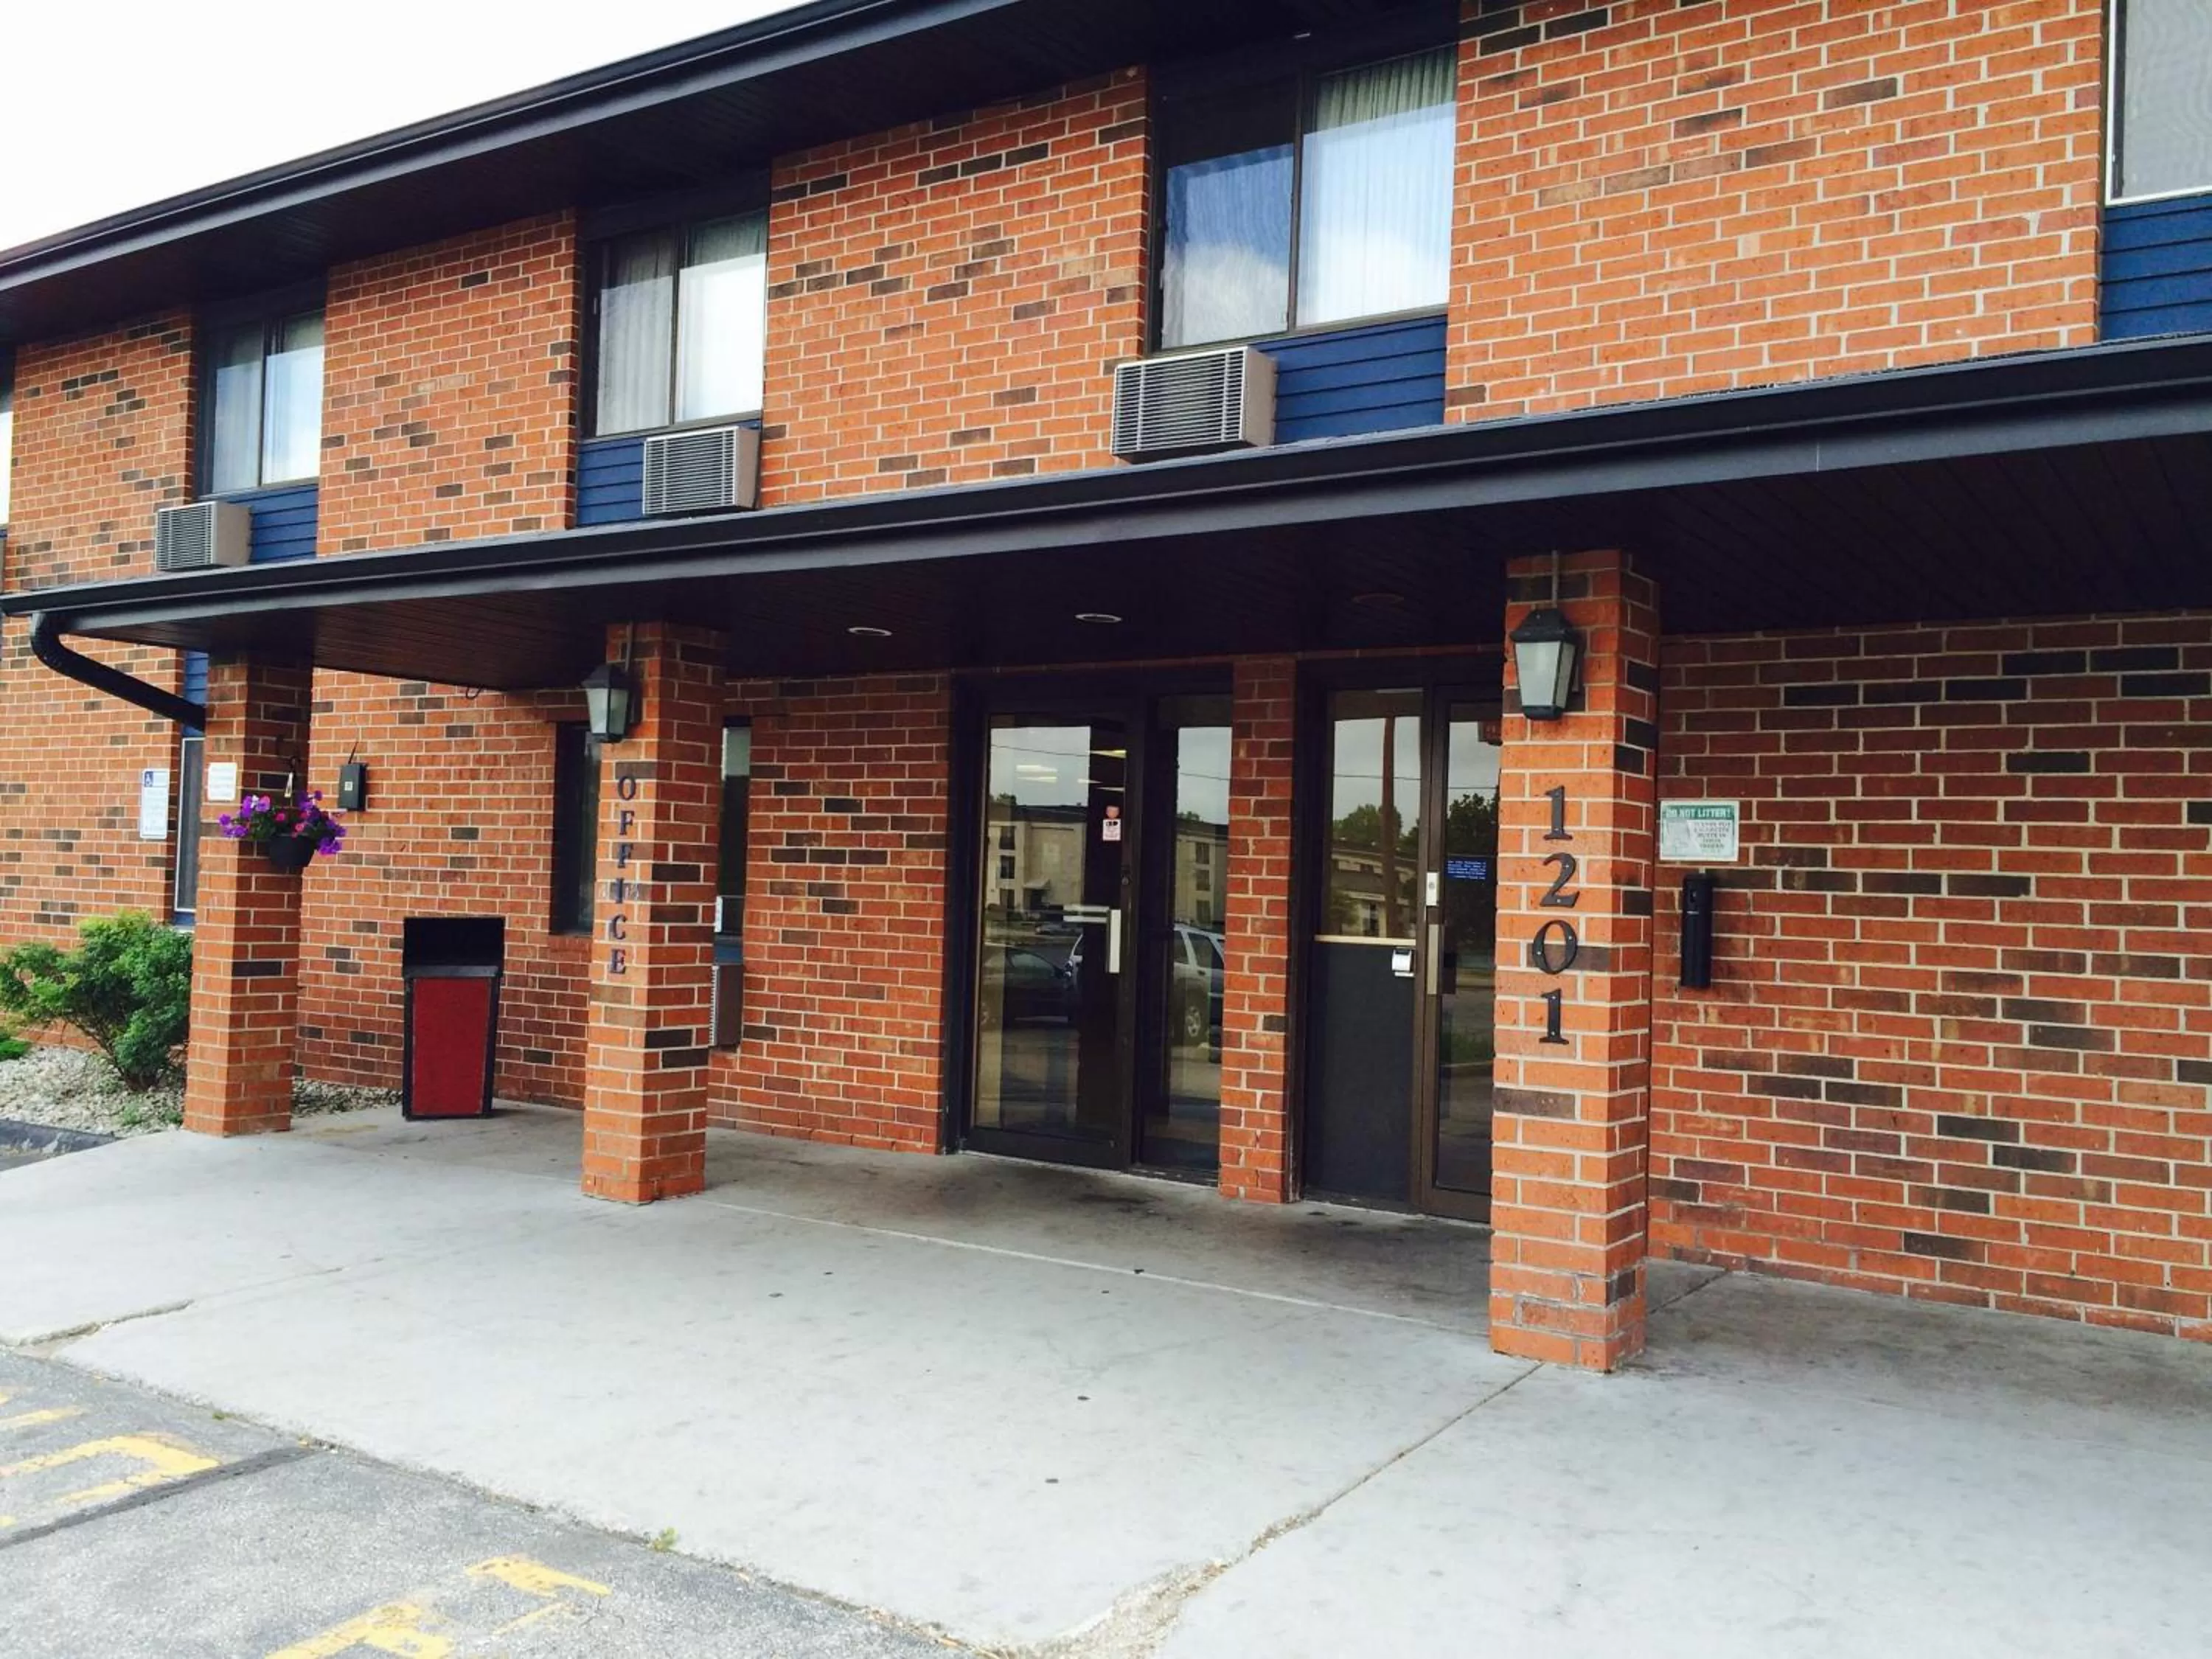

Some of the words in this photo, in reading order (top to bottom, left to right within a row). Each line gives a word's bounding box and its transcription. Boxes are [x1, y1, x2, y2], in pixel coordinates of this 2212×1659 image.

[610, 776, 636, 974] OFFICE
[1680, 808, 1696, 818] NOT
[1532, 785, 1580, 1045] 1201
